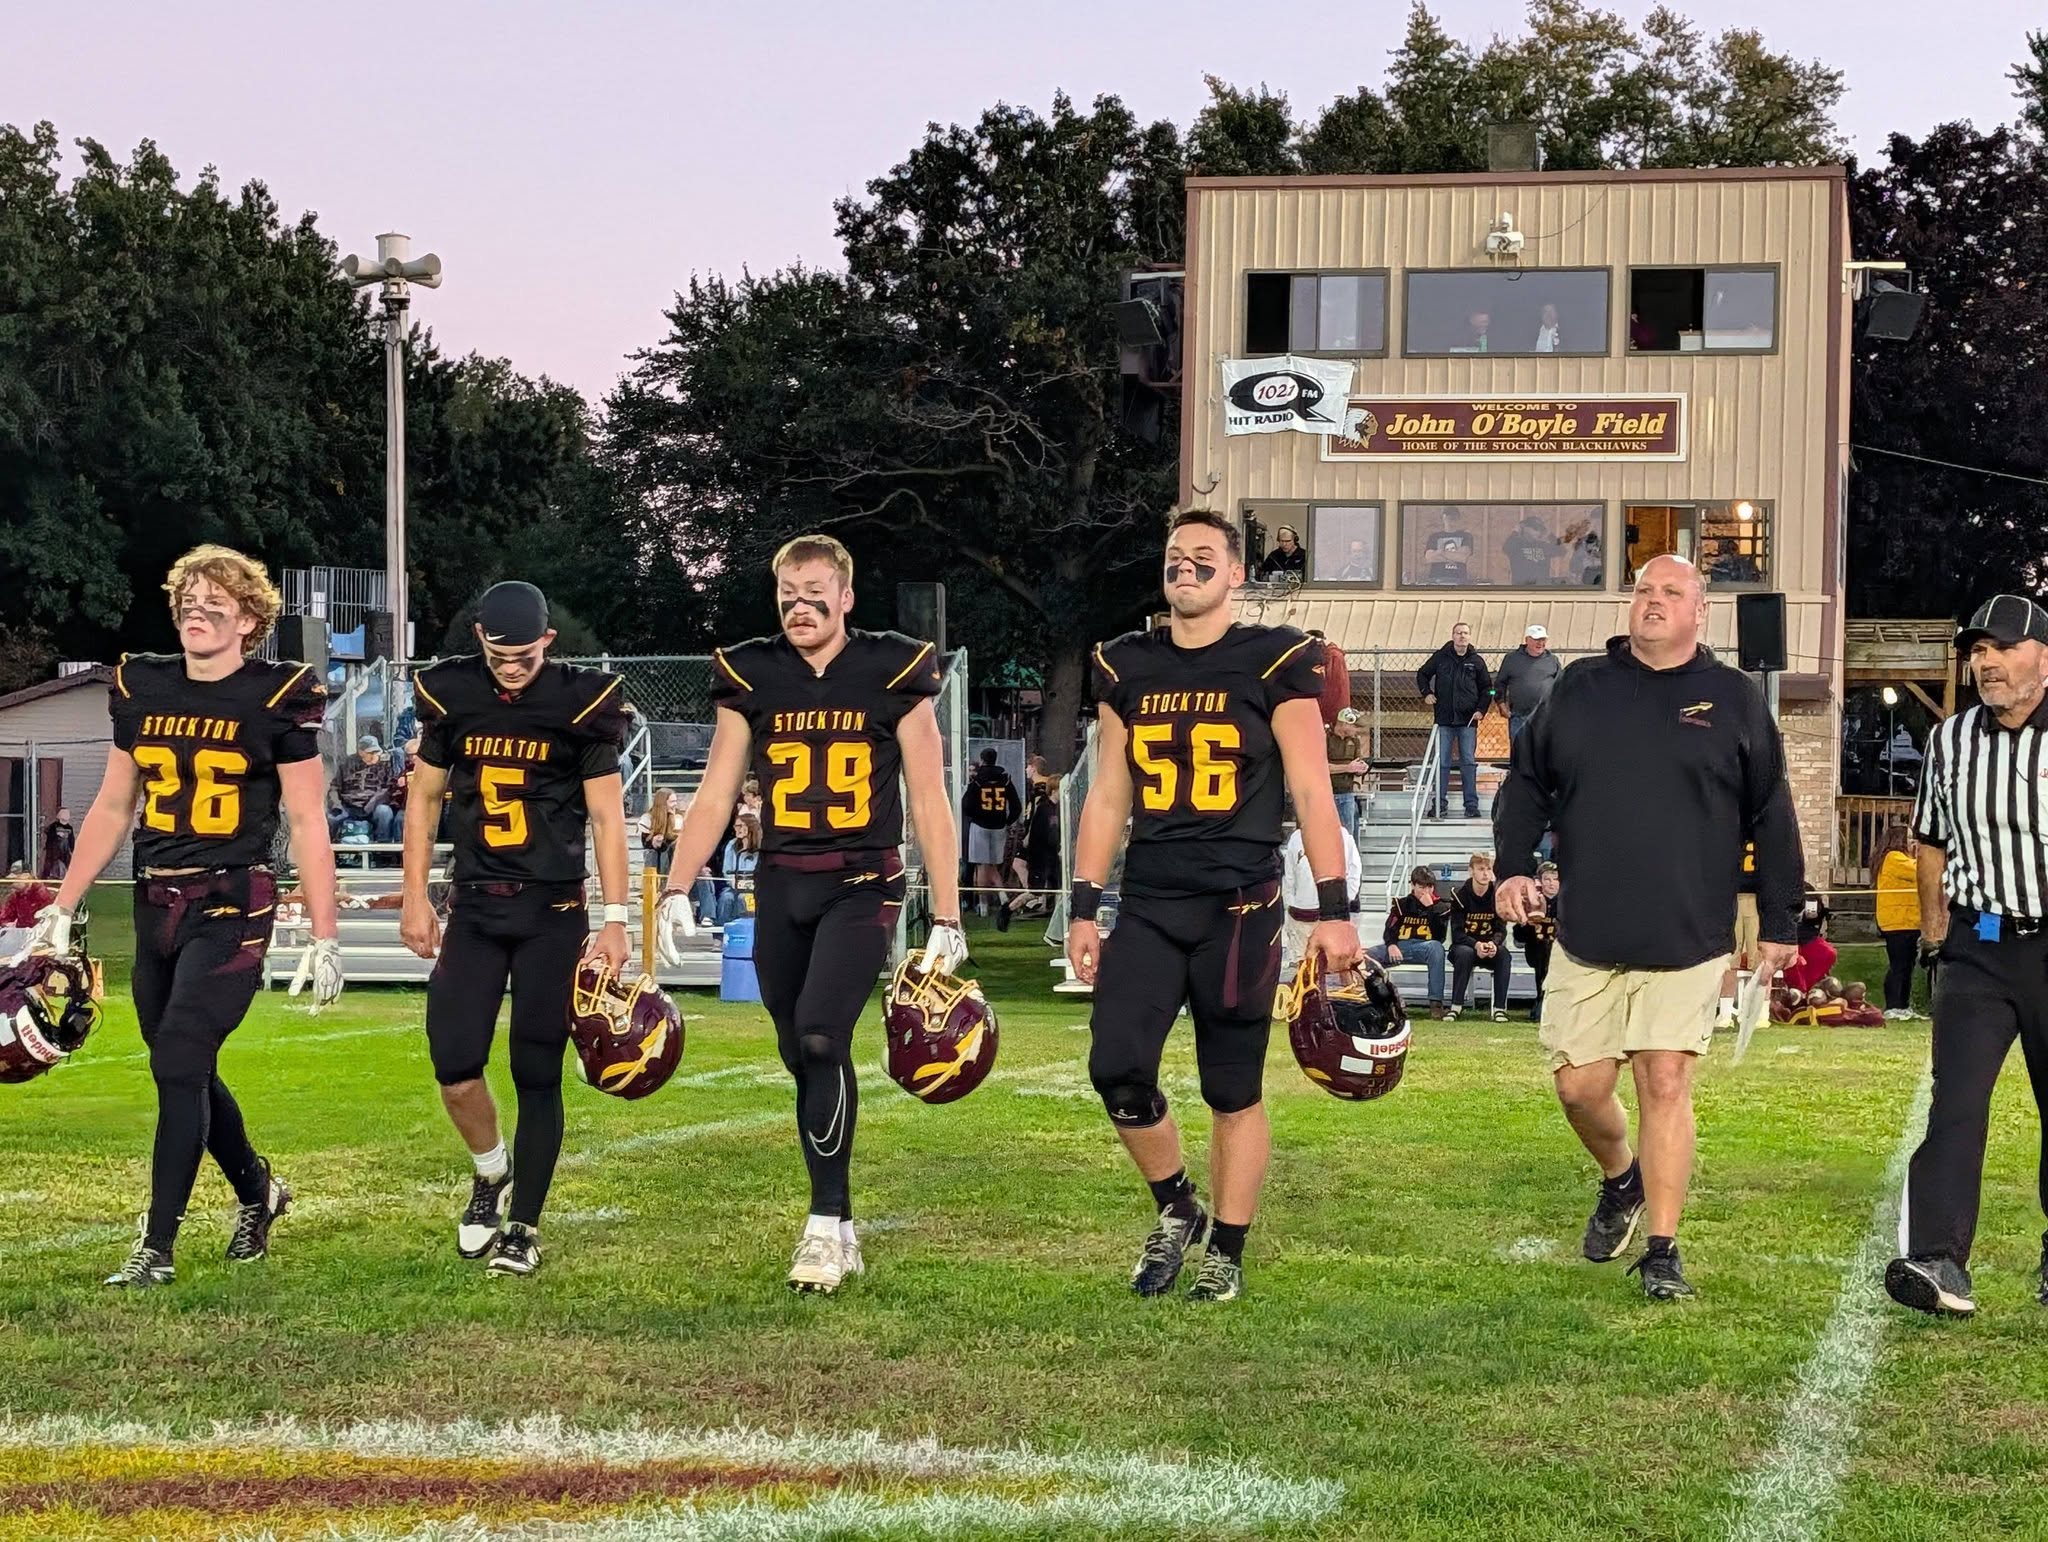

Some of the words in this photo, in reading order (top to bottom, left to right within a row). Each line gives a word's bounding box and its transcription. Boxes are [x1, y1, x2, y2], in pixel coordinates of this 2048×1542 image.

[1301, 389, 1318, 399] FM
[1229, 416, 1250, 425] HIT
[1254, 411, 1294, 424] RADIO
[1385, 413, 1456, 435] John
[1471, 412, 1578, 440] O'Boyle
[1591, 412, 1667, 435] Field
[1402, 441, 1438, 451] HOME
[1443, 441, 1460, 451] OF
[1463, 441, 1488, 451] THE
[1492, 441, 1557, 451] STOCKTON
[1562, 441, 1648, 451] BLACKHAWKS
[1140, 692, 1228, 715] STOCKTON
[141, 715, 240, 741] STOCKTON
[774, 710, 867, 733] STOCKTON
[464, 736, 551, 761] STOCKTON
[1132, 722, 1241, 812] 56
[133, 745, 248, 834] 26
[766, 741, 873, 829] 29
[480, 764, 529, 848] 5
[981, 787, 1006, 811] 55
